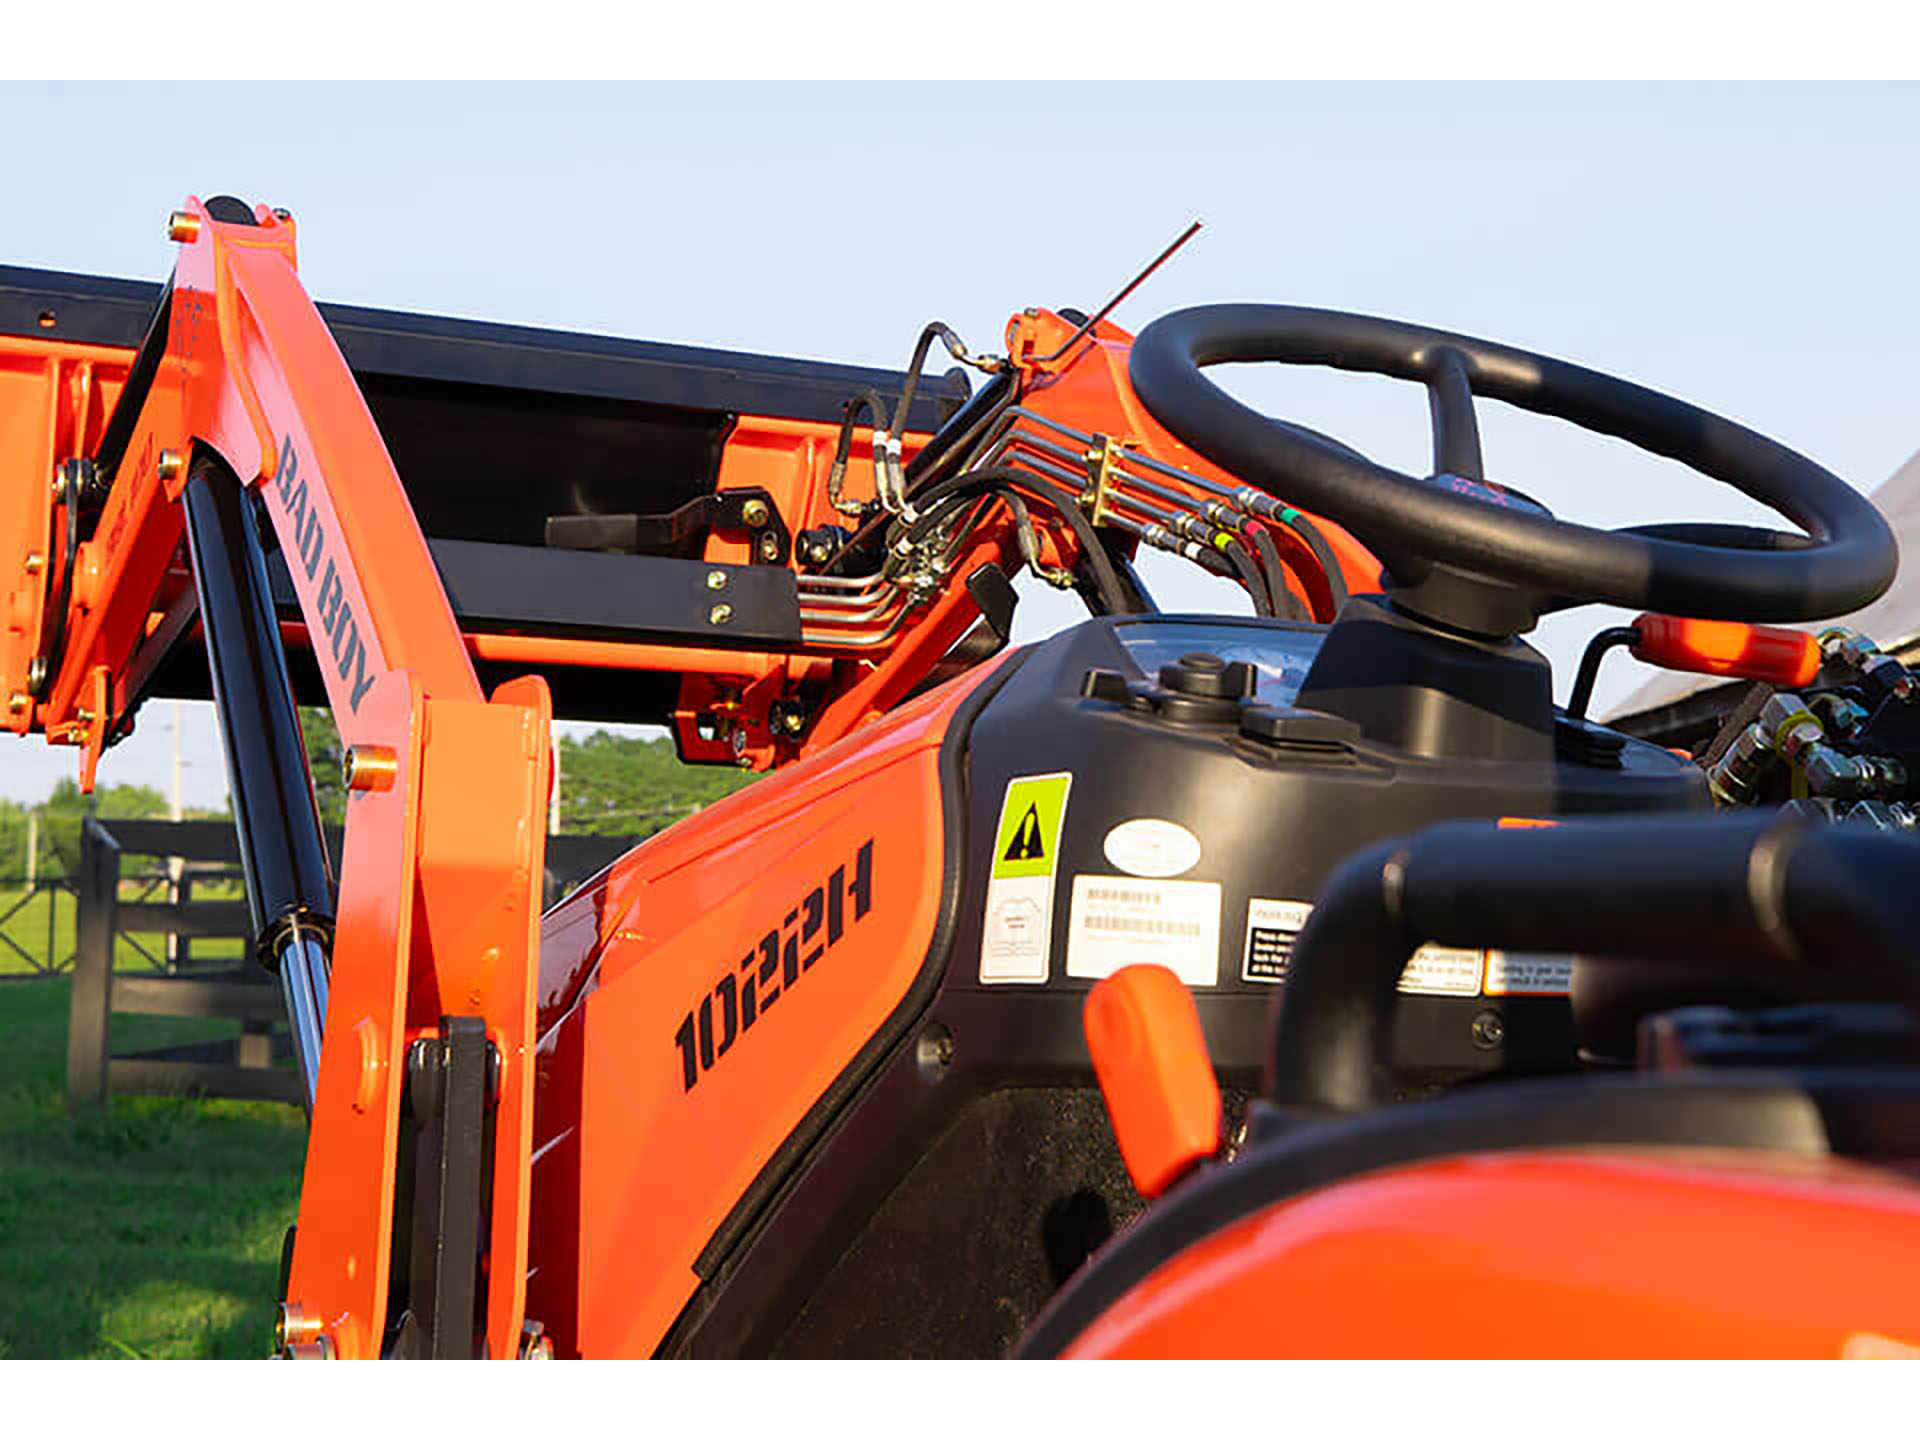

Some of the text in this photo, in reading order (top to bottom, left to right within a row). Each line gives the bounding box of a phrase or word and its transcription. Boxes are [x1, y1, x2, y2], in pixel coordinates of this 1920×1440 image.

[275, 434, 376, 715] BAD BOY
[674, 837, 875, 1094] 1022H
